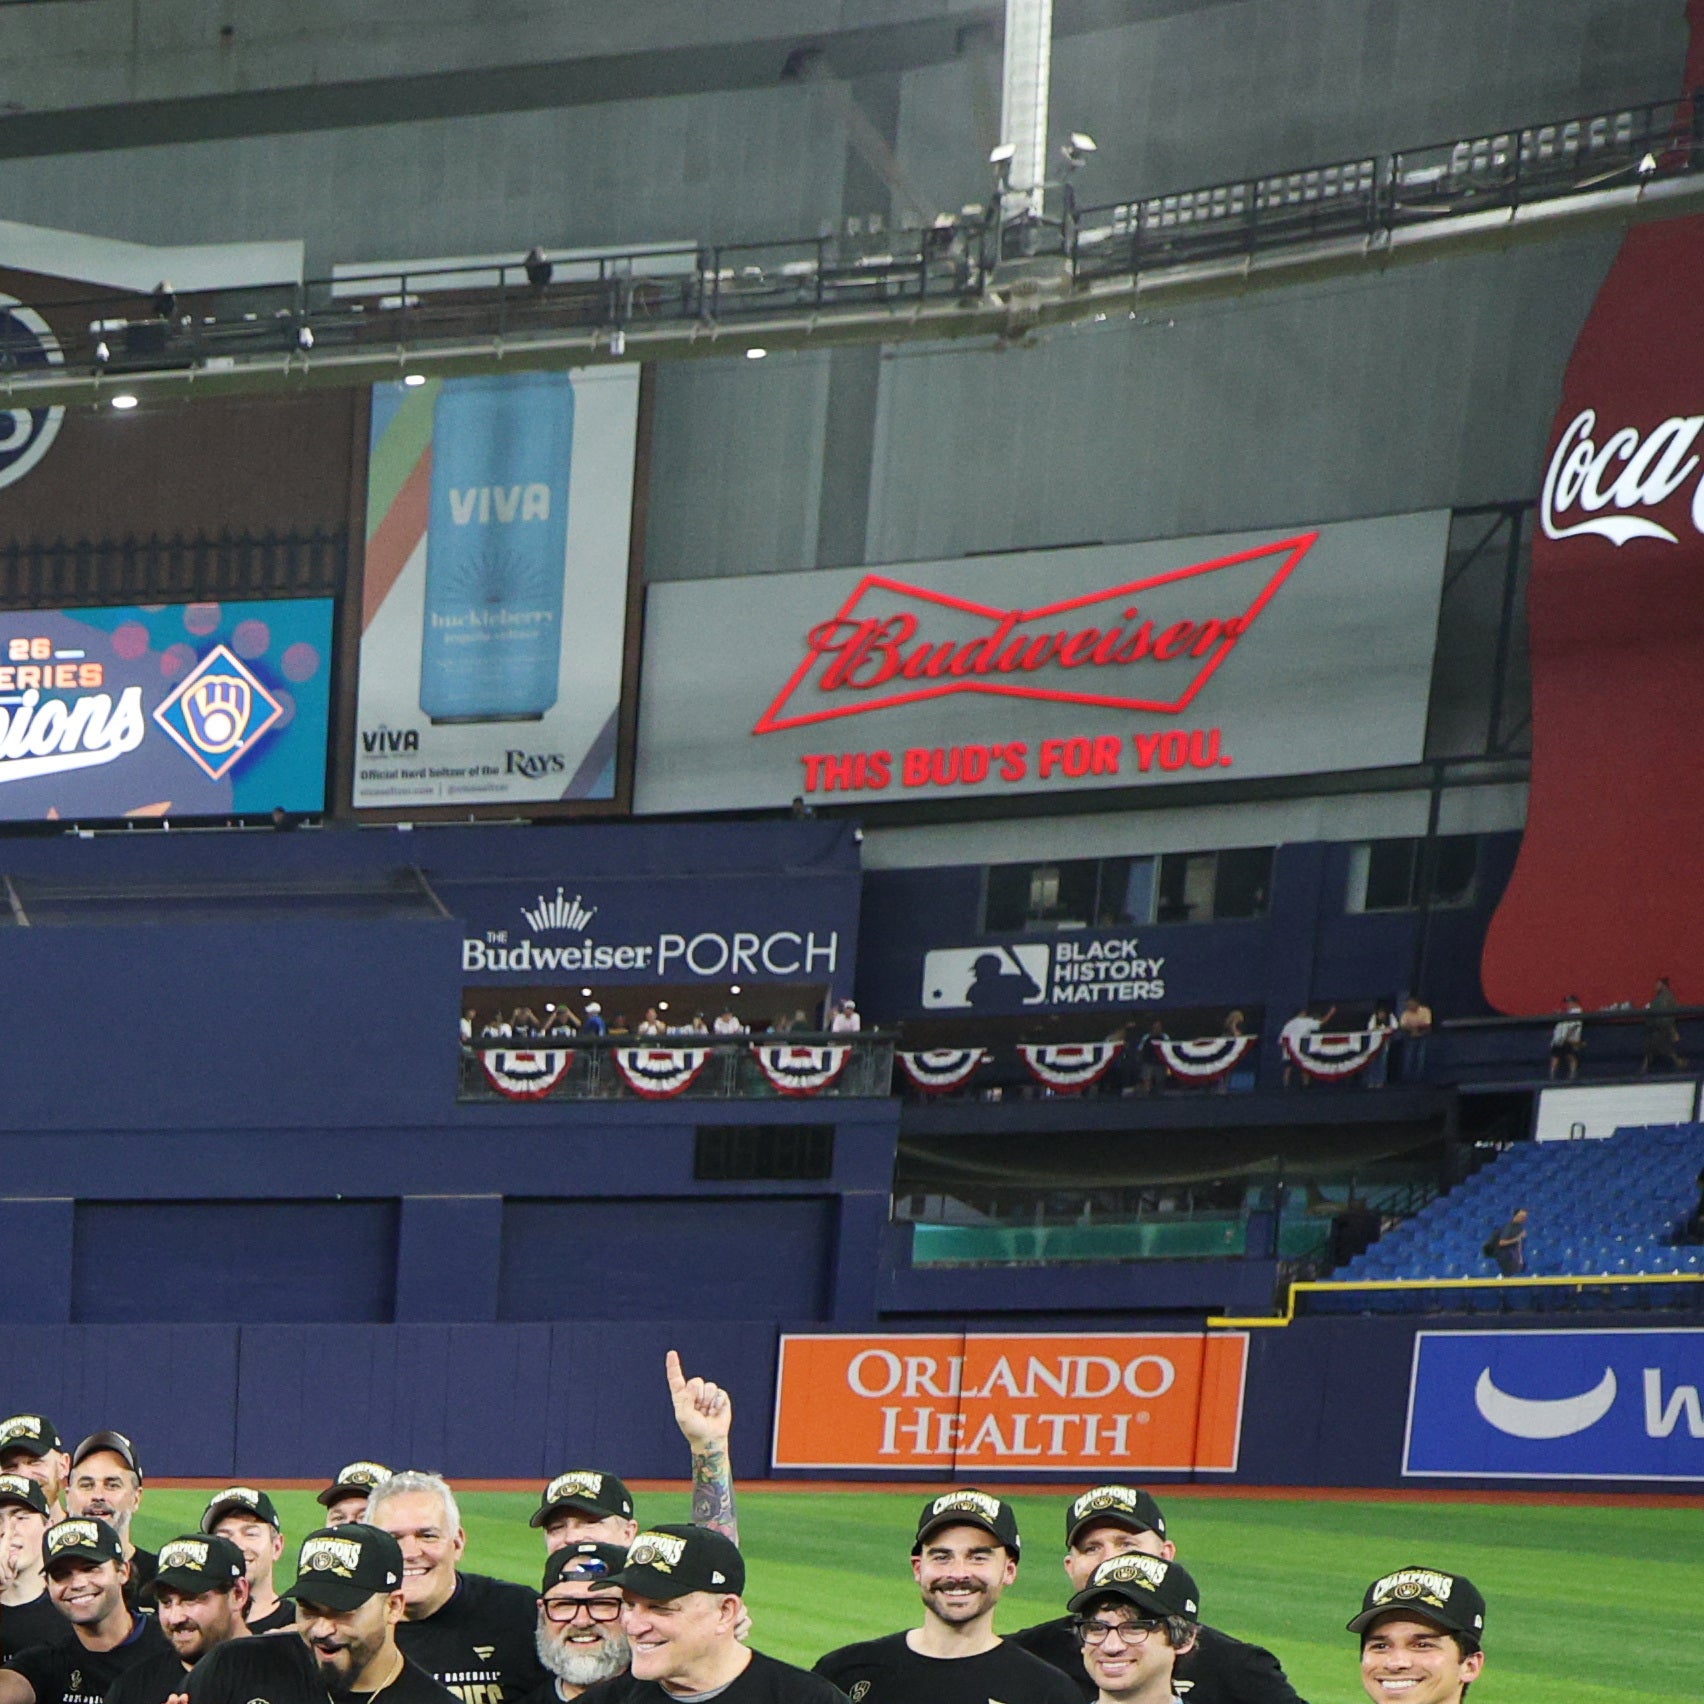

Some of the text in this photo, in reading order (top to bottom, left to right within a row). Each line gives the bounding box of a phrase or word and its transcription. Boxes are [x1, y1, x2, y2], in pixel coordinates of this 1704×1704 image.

[449, 484, 550, 525] VIVA
[9, 637, 52, 661] 26
[804, 605, 1246, 693] Budweiser
[363, 729, 420, 753] VIVA
[803, 728, 1232, 793] THIS BUD'S FOR YOU.
[486, 931, 508, 943] THE
[1056, 939, 1138, 961] BLACK
[463, 931, 838, 977] Budweiser PORCH
[1054, 958, 1166, 982] HISTORY
[1052, 980, 1165, 1004] MATTERS
[846, 1349, 1177, 1399] ORLANDO
[879, 1405, 1150, 1457] HEALTH
[546, 1471, 604, 1500] CHAMPIONS
[1073, 1486, 1137, 1512] CHAMPIONS
[933, 1490, 1000, 1518] CHAMPIONS
[49, 1521, 98, 1549] CHAMPIONS
[158, 1540, 208, 1569] CHAMPIONS
[298, 1541, 361, 1573] CHAMPIONS
[1096, 1556, 1168, 1586] CHAMPIONS
[1374, 1569, 1453, 1602] CHAMPIONS
